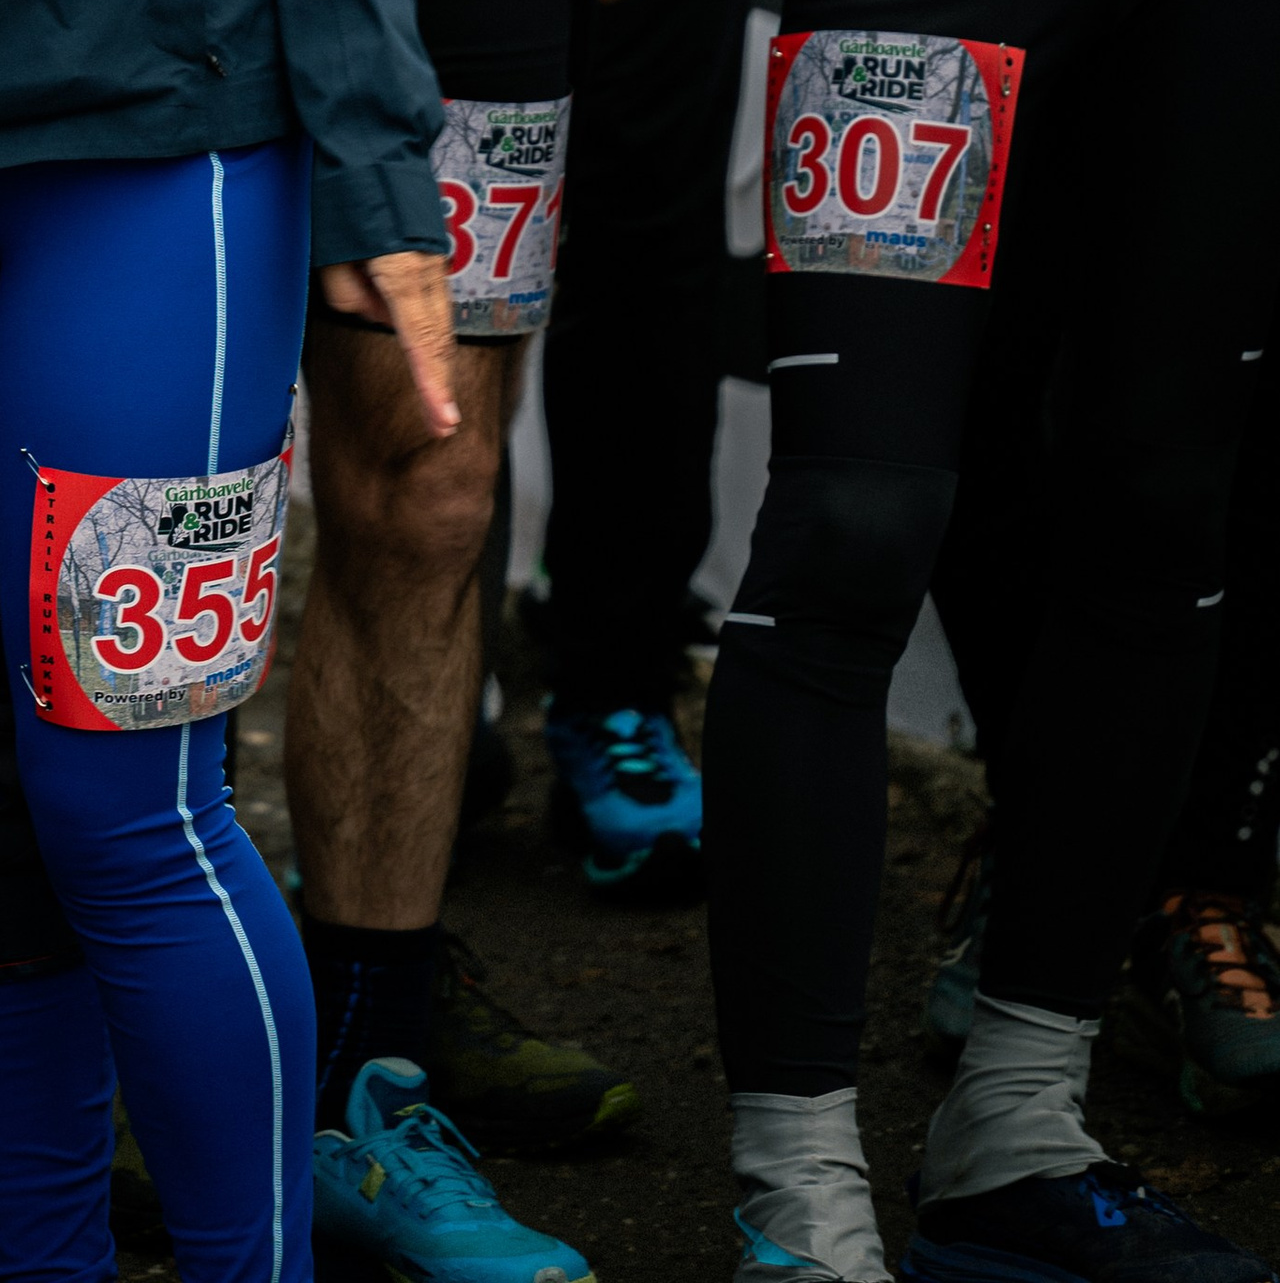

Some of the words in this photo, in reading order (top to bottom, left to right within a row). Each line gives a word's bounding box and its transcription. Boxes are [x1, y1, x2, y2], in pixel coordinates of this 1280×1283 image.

[839, 39, 926, 58] Gârboavele
[852, 66, 868, 83] &
[863, 56, 926, 81] RUN
[860, 78, 924, 101] RIDE
[500, 136, 515, 153] &
[511, 124, 557, 146] RUN
[508, 145, 554, 165] RIDE
[782, 113, 972, 224] 307
[828, 235, 845, 248] by
[866, 230, 927, 248] maus
[165, 477, 254, 502] Gârboavele
[194, 492, 254, 522] RUN
[183, 513, 200, 531] &
[193, 513, 251, 544] RIDE
[44, 498, 56, 572] TRAIL
[43, 593, 52, 634] RUN
[91, 532, 281, 675] 355
[205, 658, 252, 687] maus
[94, 691, 163, 704] Powered
[169, 687, 186, 701] by
